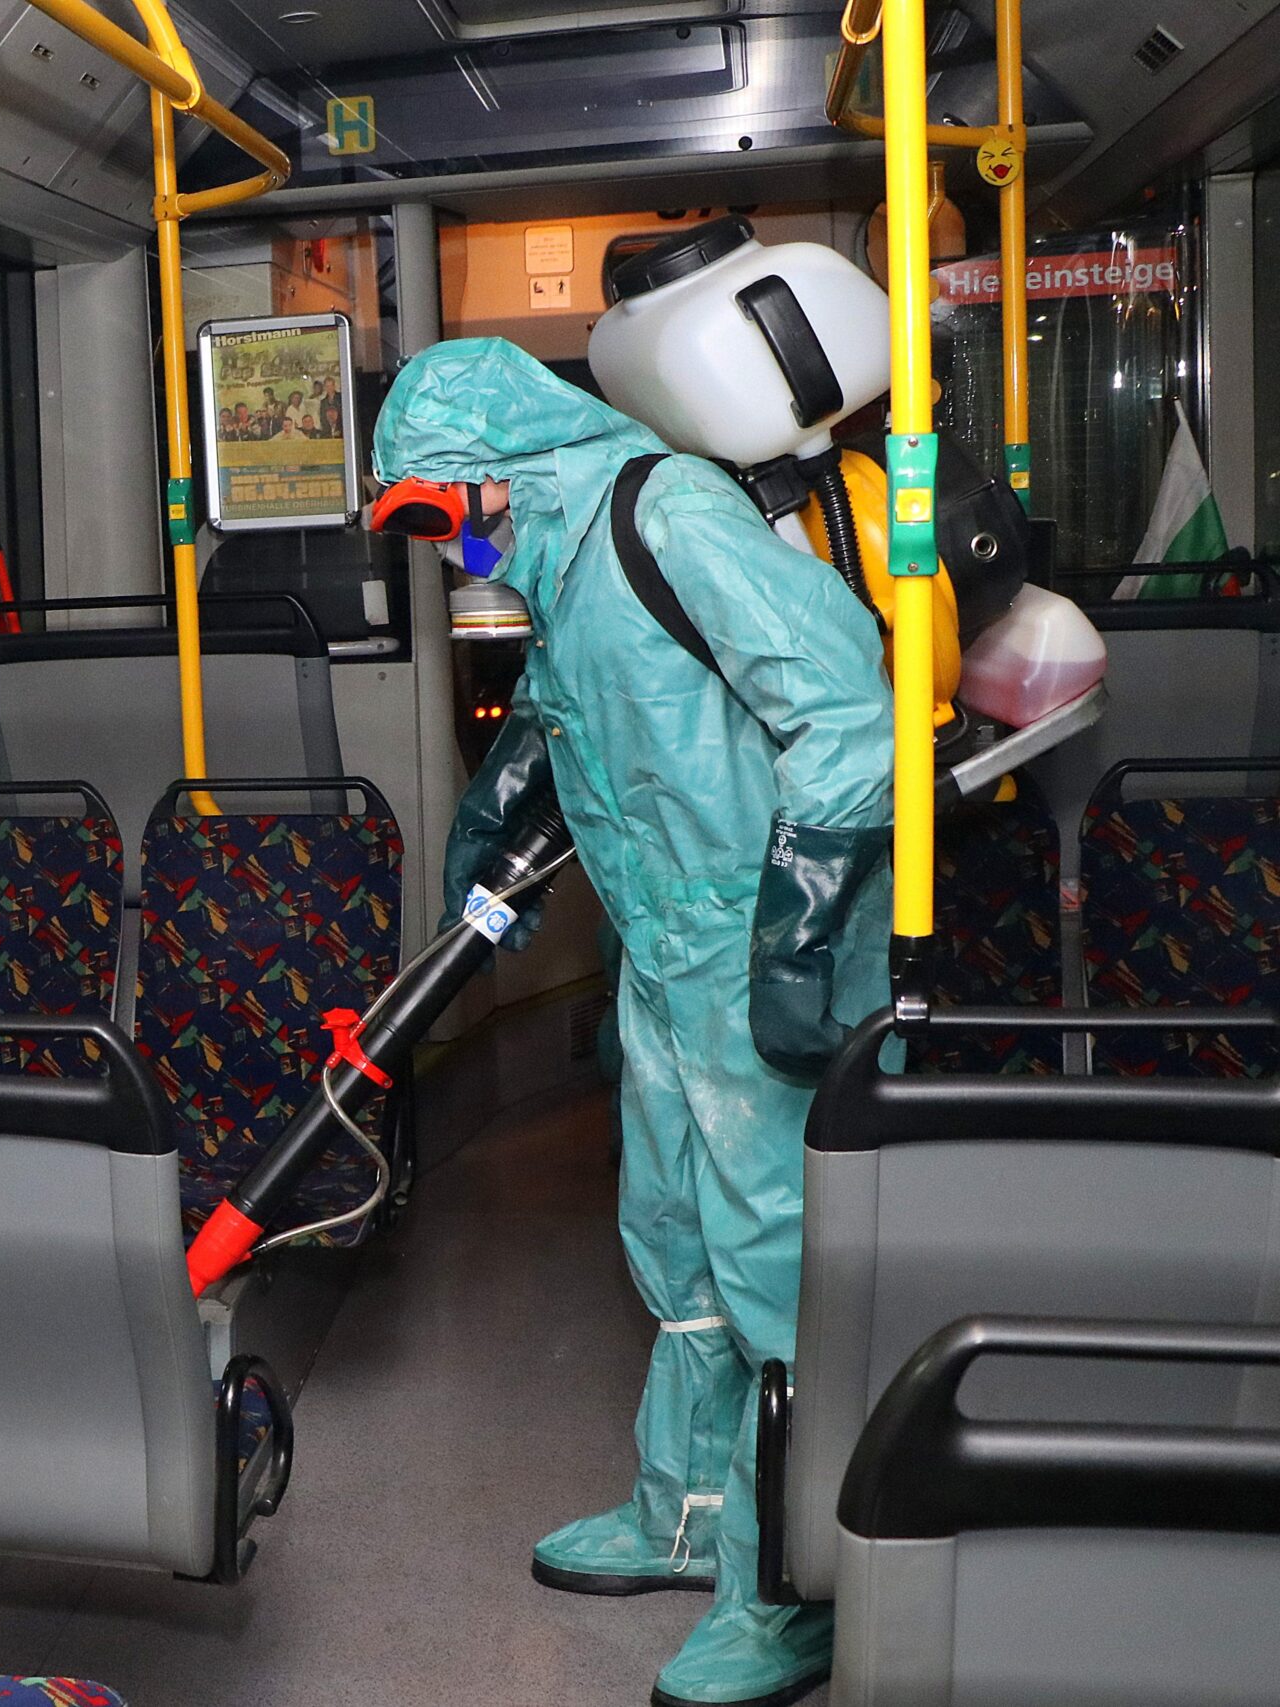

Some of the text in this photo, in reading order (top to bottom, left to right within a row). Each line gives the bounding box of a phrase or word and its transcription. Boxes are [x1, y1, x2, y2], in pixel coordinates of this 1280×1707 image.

[334, 102, 369, 149] H
[949, 258, 1175, 296] Hie einsteige
[214, 327, 302, 348] Horstmann
